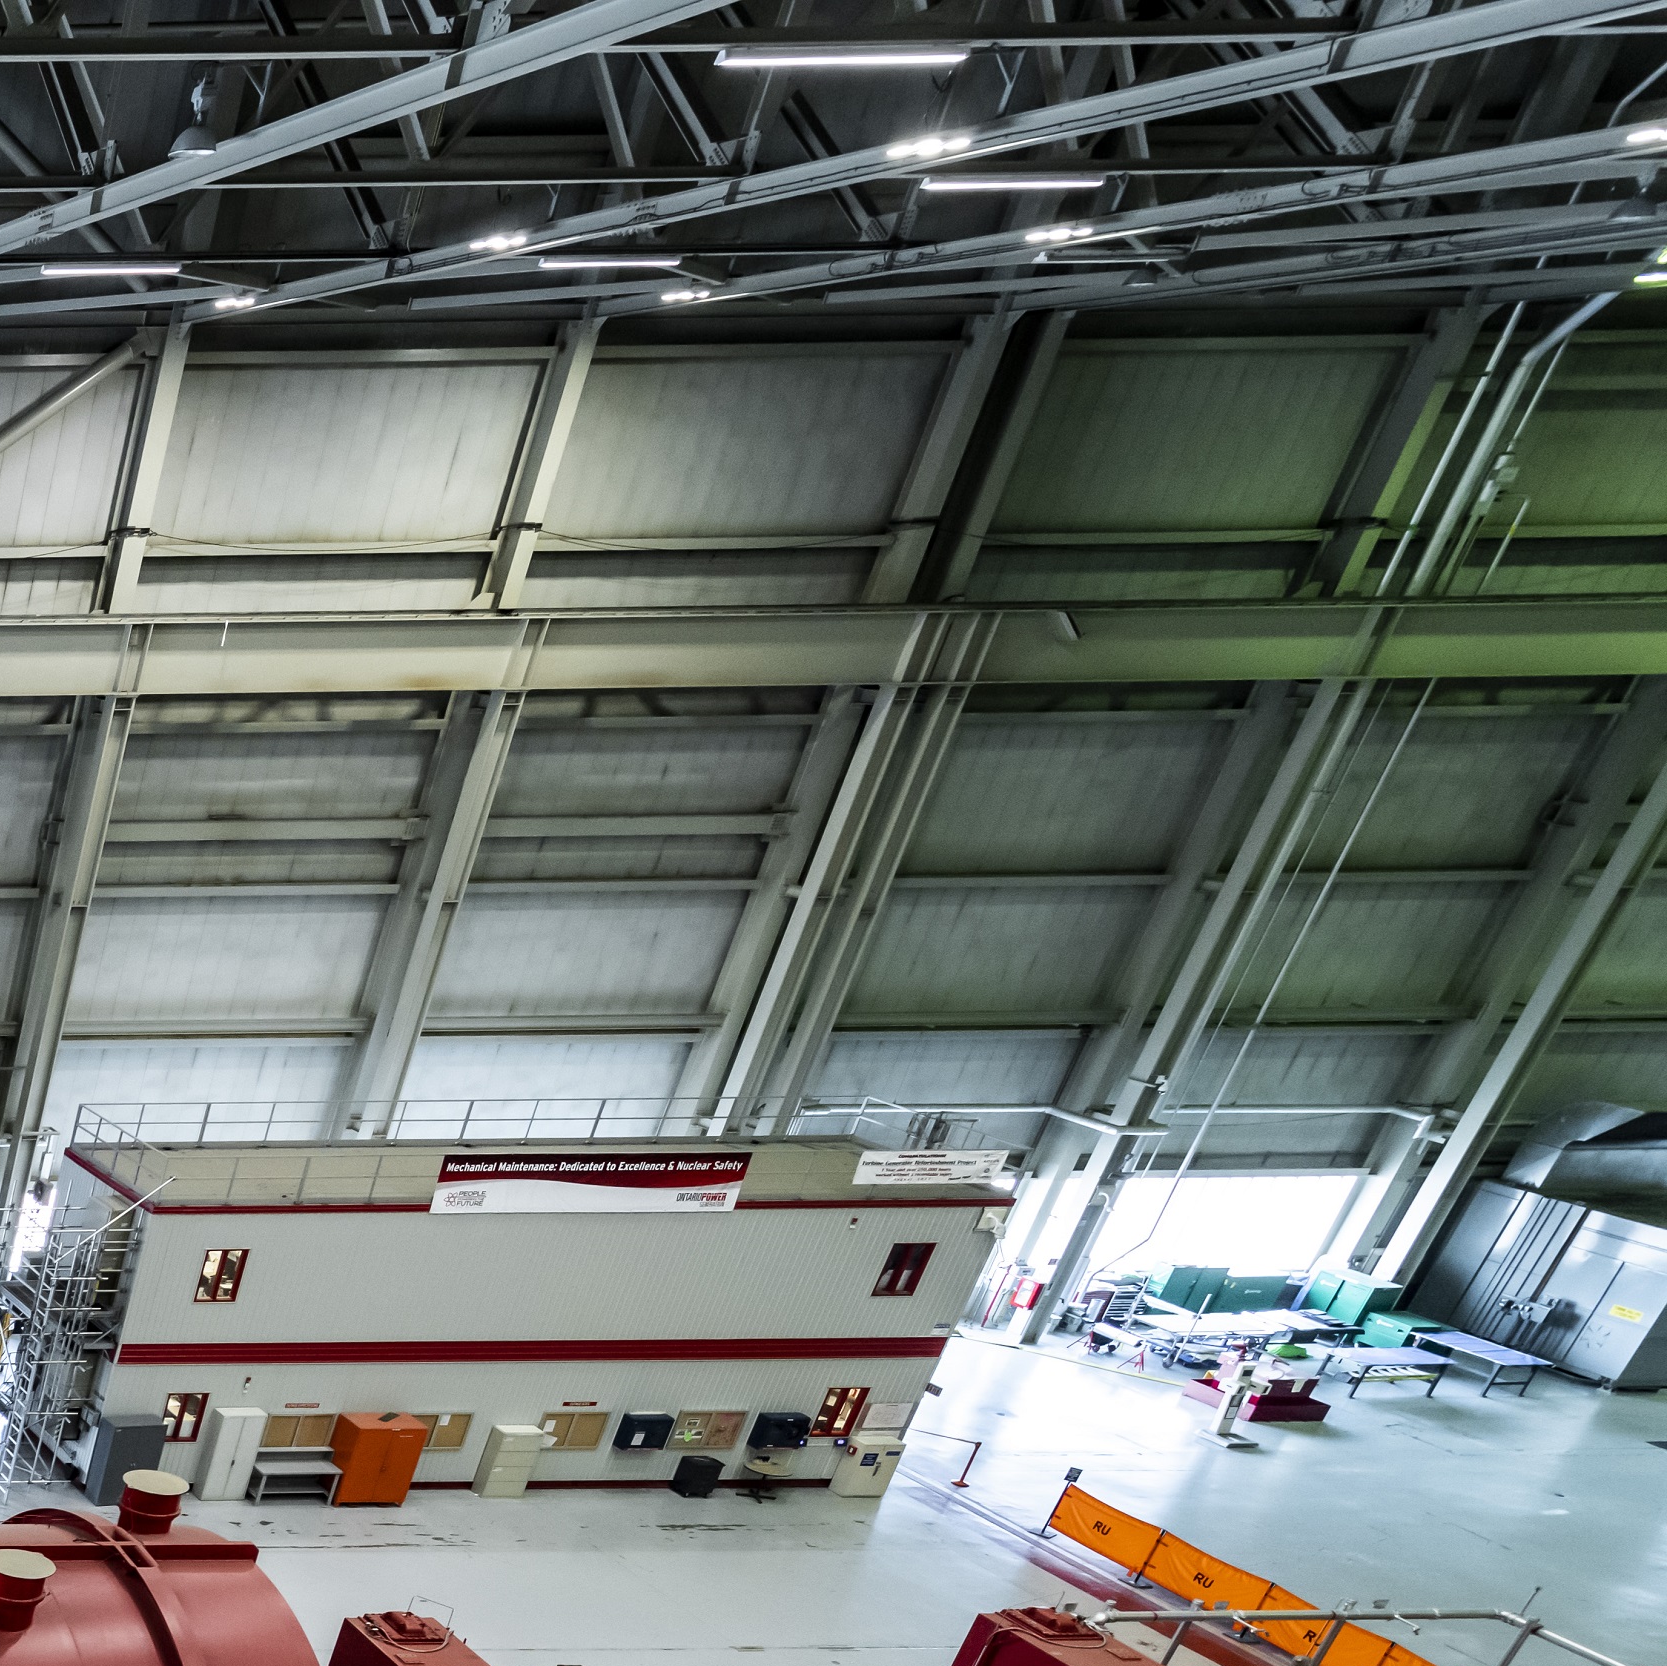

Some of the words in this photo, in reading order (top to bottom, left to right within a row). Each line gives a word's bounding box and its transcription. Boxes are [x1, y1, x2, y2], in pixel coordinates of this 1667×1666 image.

[446, 1162, 496, 1172] Mechanical
[498, 1162, 557, 1172] Maintenance:
[559, 1161, 603, 1172] Dedicated
[606, 1162, 616, 1171] to
[618, 1161, 666, 1171] Excellence
[668, 1161, 674, 1171] &
[676, 1161, 713, 1171] Nuclear
[713, 1160, 744, 1172] Safety
[1092, 1520, 1112, 1536] RU
[1193, 1572, 1215, 1589] RU
